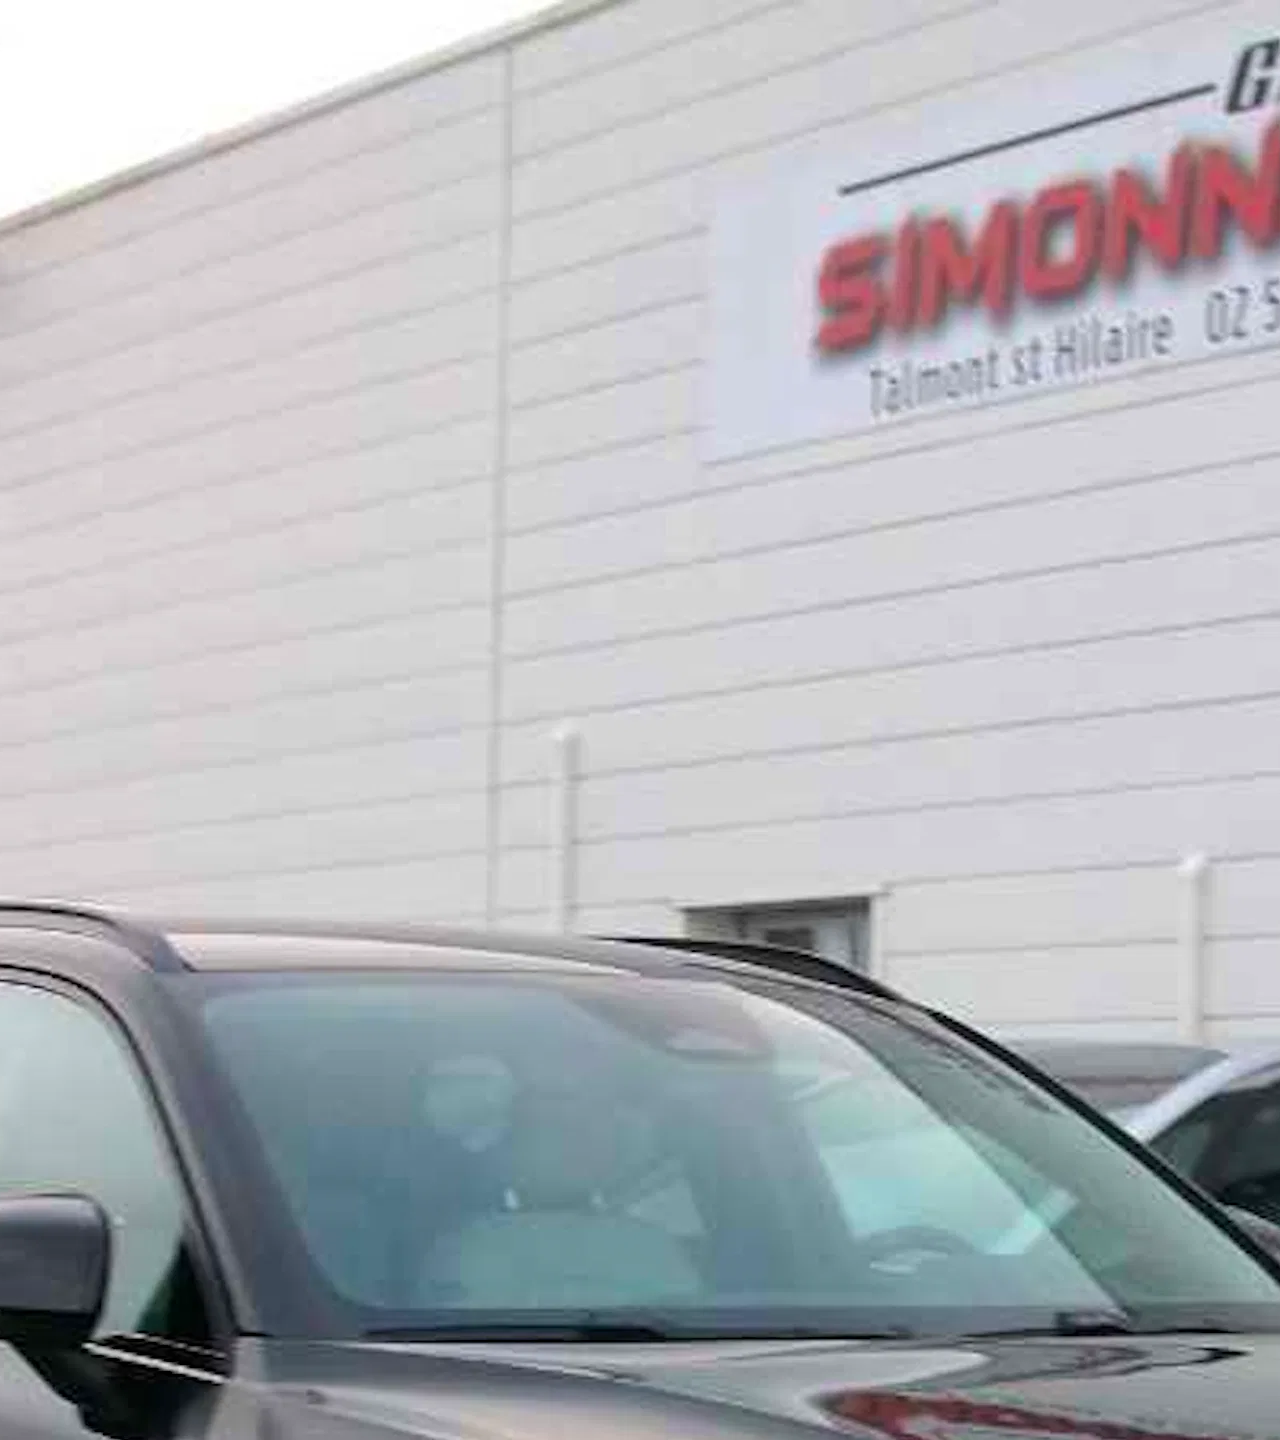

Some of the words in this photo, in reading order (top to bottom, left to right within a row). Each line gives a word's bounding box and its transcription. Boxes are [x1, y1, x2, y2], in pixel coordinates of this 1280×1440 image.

[870, 348, 999, 417] Talmont
[1010, 336, 1042, 385] st
[1052, 310, 1172, 376] Hilaire
[1204, 284, 1251, 343] 02
